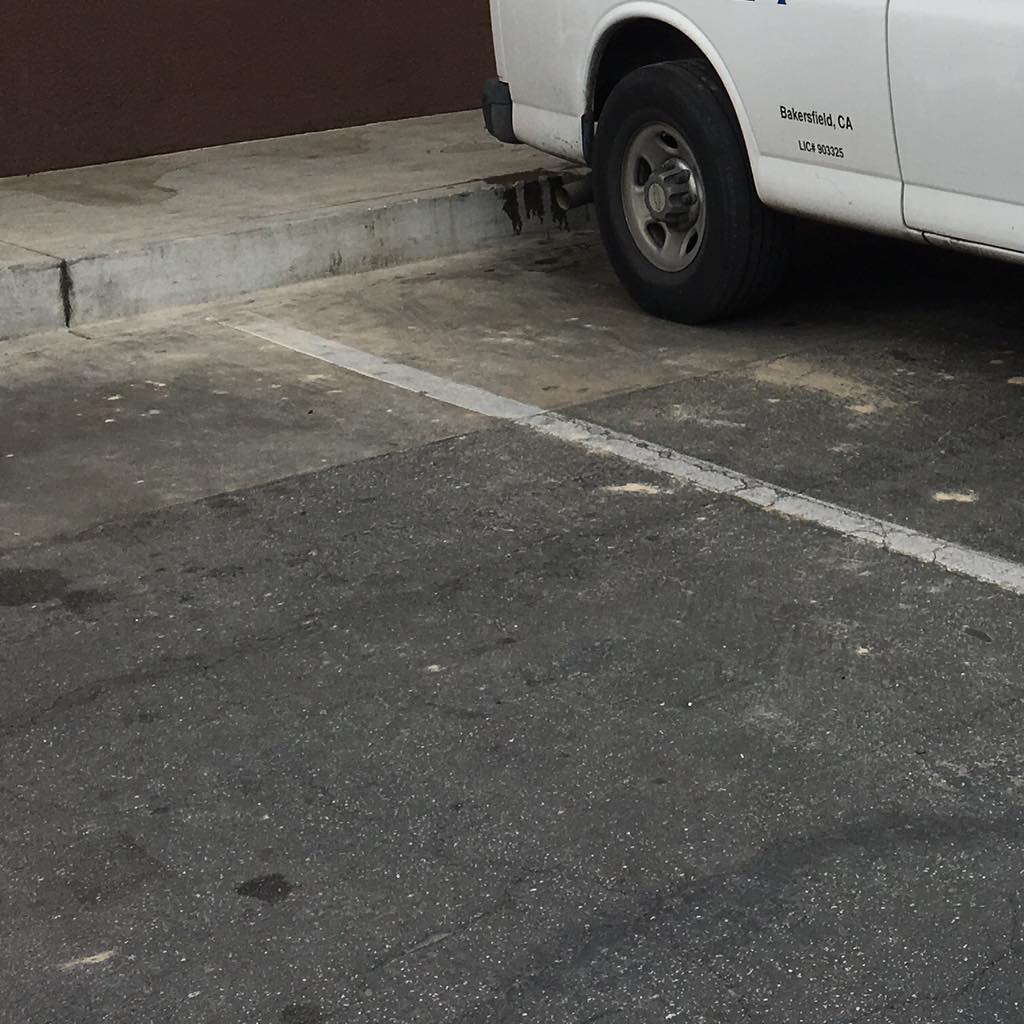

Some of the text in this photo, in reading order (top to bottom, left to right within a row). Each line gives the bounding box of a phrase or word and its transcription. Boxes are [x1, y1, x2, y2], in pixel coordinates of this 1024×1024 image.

[779, 105, 854, 131] Bakersfield, CA
[798, 140, 845, 158] LIC# 903325
